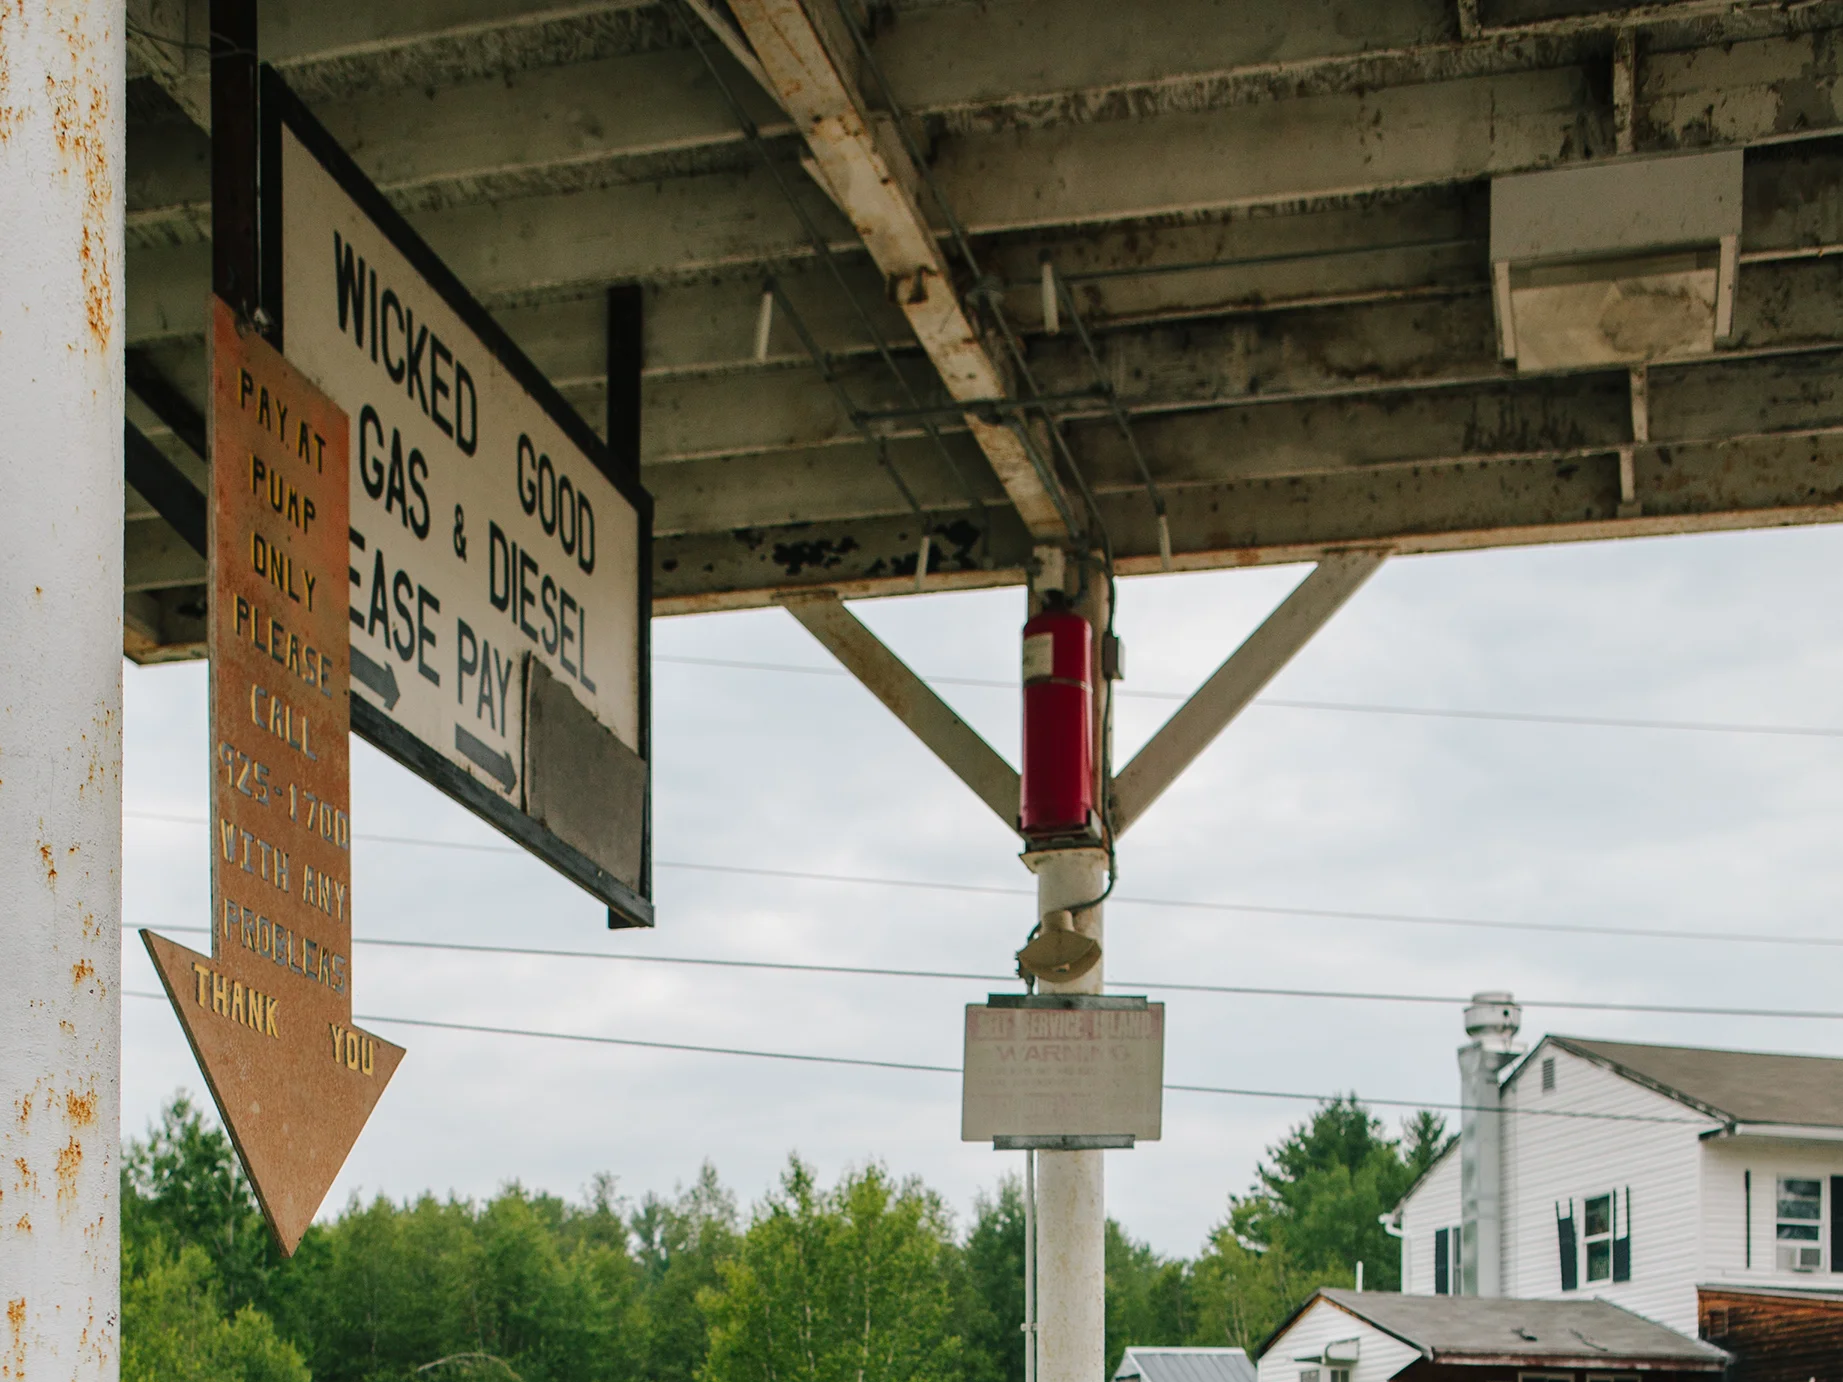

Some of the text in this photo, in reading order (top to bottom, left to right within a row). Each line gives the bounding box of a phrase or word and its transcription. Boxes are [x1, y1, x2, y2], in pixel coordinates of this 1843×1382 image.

[237, 366, 327, 474] PAY AT
[333, 230, 596, 576] WICKED GOOD
[250, 452, 317, 535] PUMP
[251, 531, 317, 613] ONLY
[357, 404, 597, 696] GAS & DIESEL
[233, 592, 333, 698] PLEASE
[456, 616, 514, 740] PAY
[250, 682, 318, 762] CALL
[218, 740, 350, 851] 925-1700
[219, 818, 348, 924] WITH ANY
[223, 897, 347, 996] PROBLEMS
[191, 960, 375, 1077] THANK YOU
